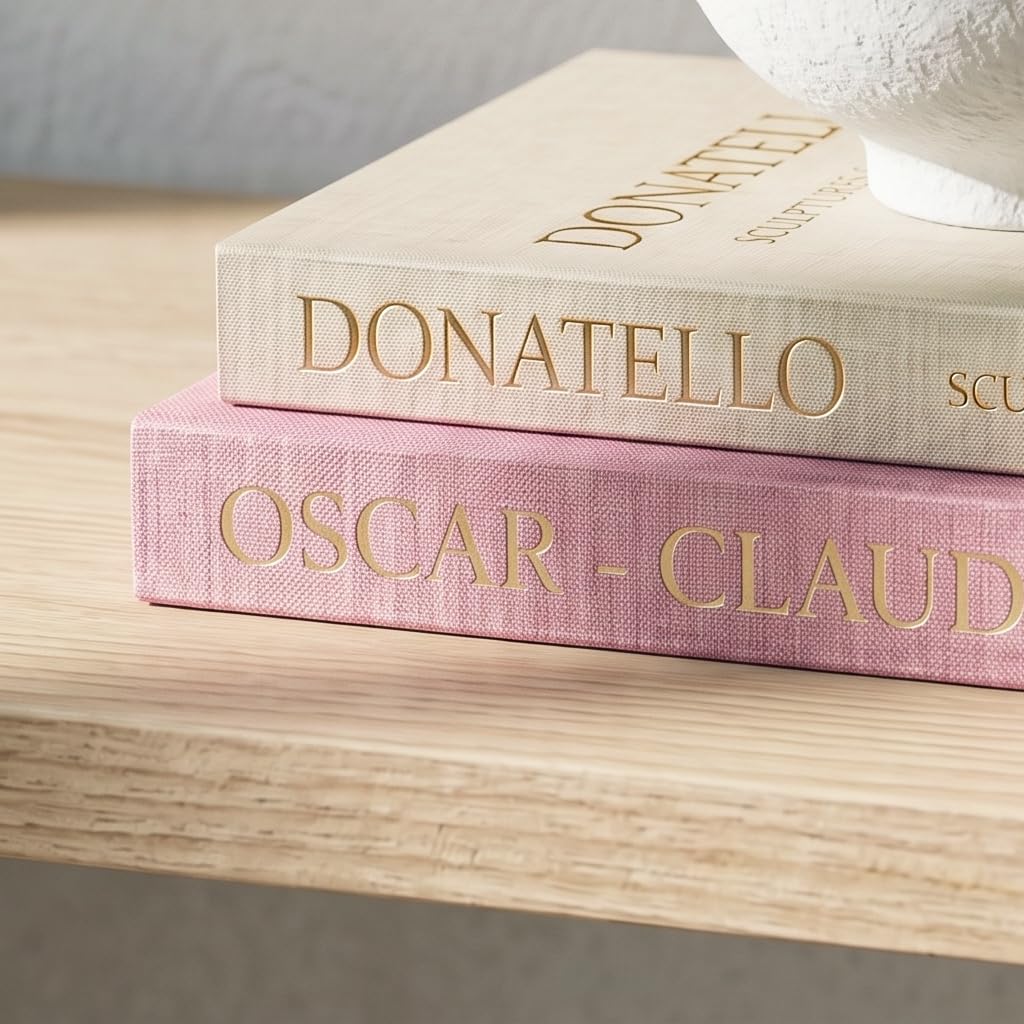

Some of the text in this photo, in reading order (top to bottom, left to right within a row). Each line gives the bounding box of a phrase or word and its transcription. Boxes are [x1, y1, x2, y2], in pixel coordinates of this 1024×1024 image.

[533, 113, 842, 250] DONATELL
[297, 294, 847, 419] DONATELLO
[220, 485, 564, 595] OSCAR
[597, 563, 627, 576] -
